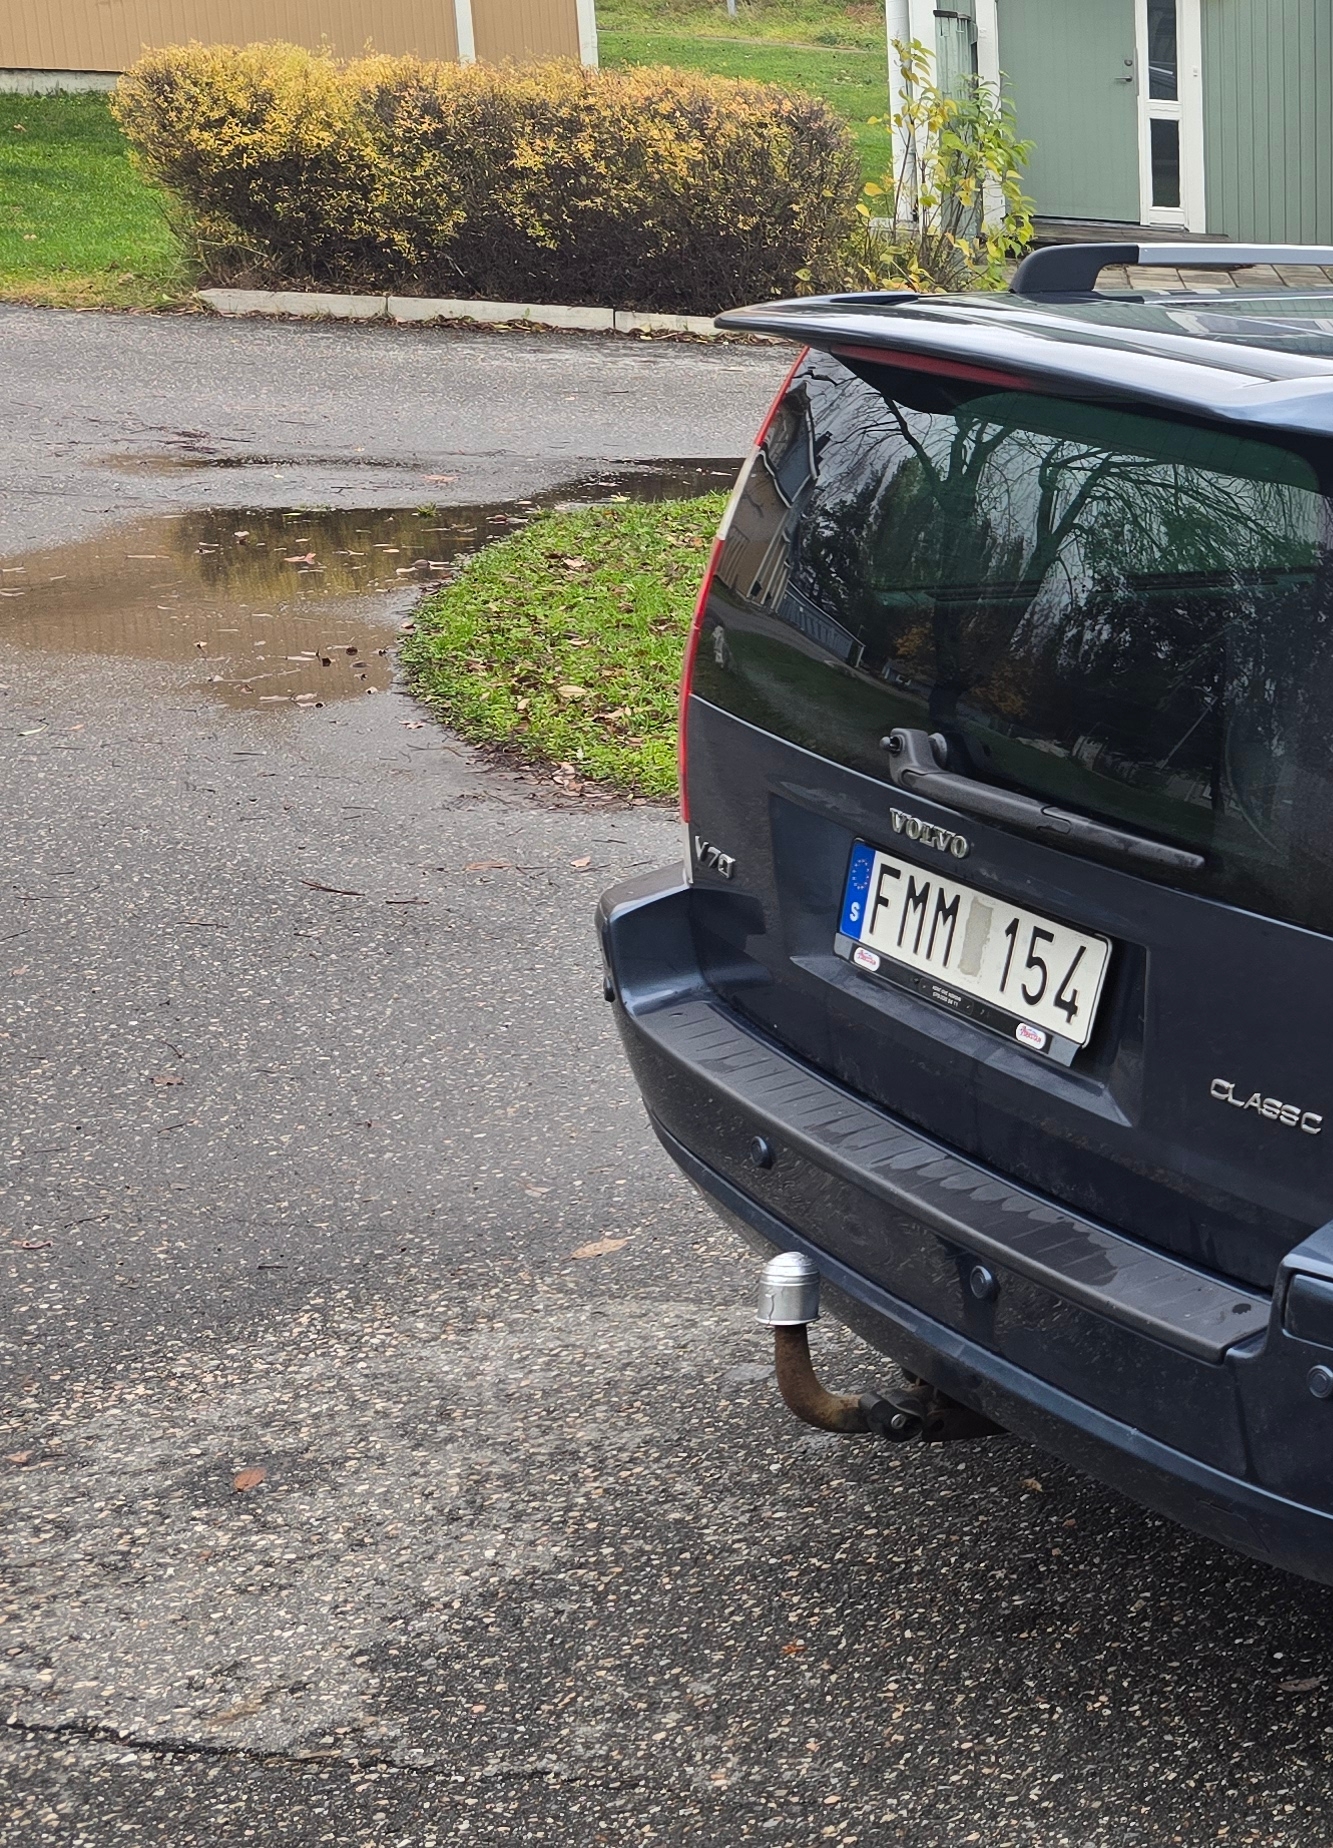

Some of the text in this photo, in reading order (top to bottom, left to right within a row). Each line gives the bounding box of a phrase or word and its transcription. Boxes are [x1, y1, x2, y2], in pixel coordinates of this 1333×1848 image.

[694, 835, 736, 879] V70
[889, 807, 968, 859] VOLVO
[849, 901, 859, 922] S
[868, 863, 1087, 1025] FMM 154
